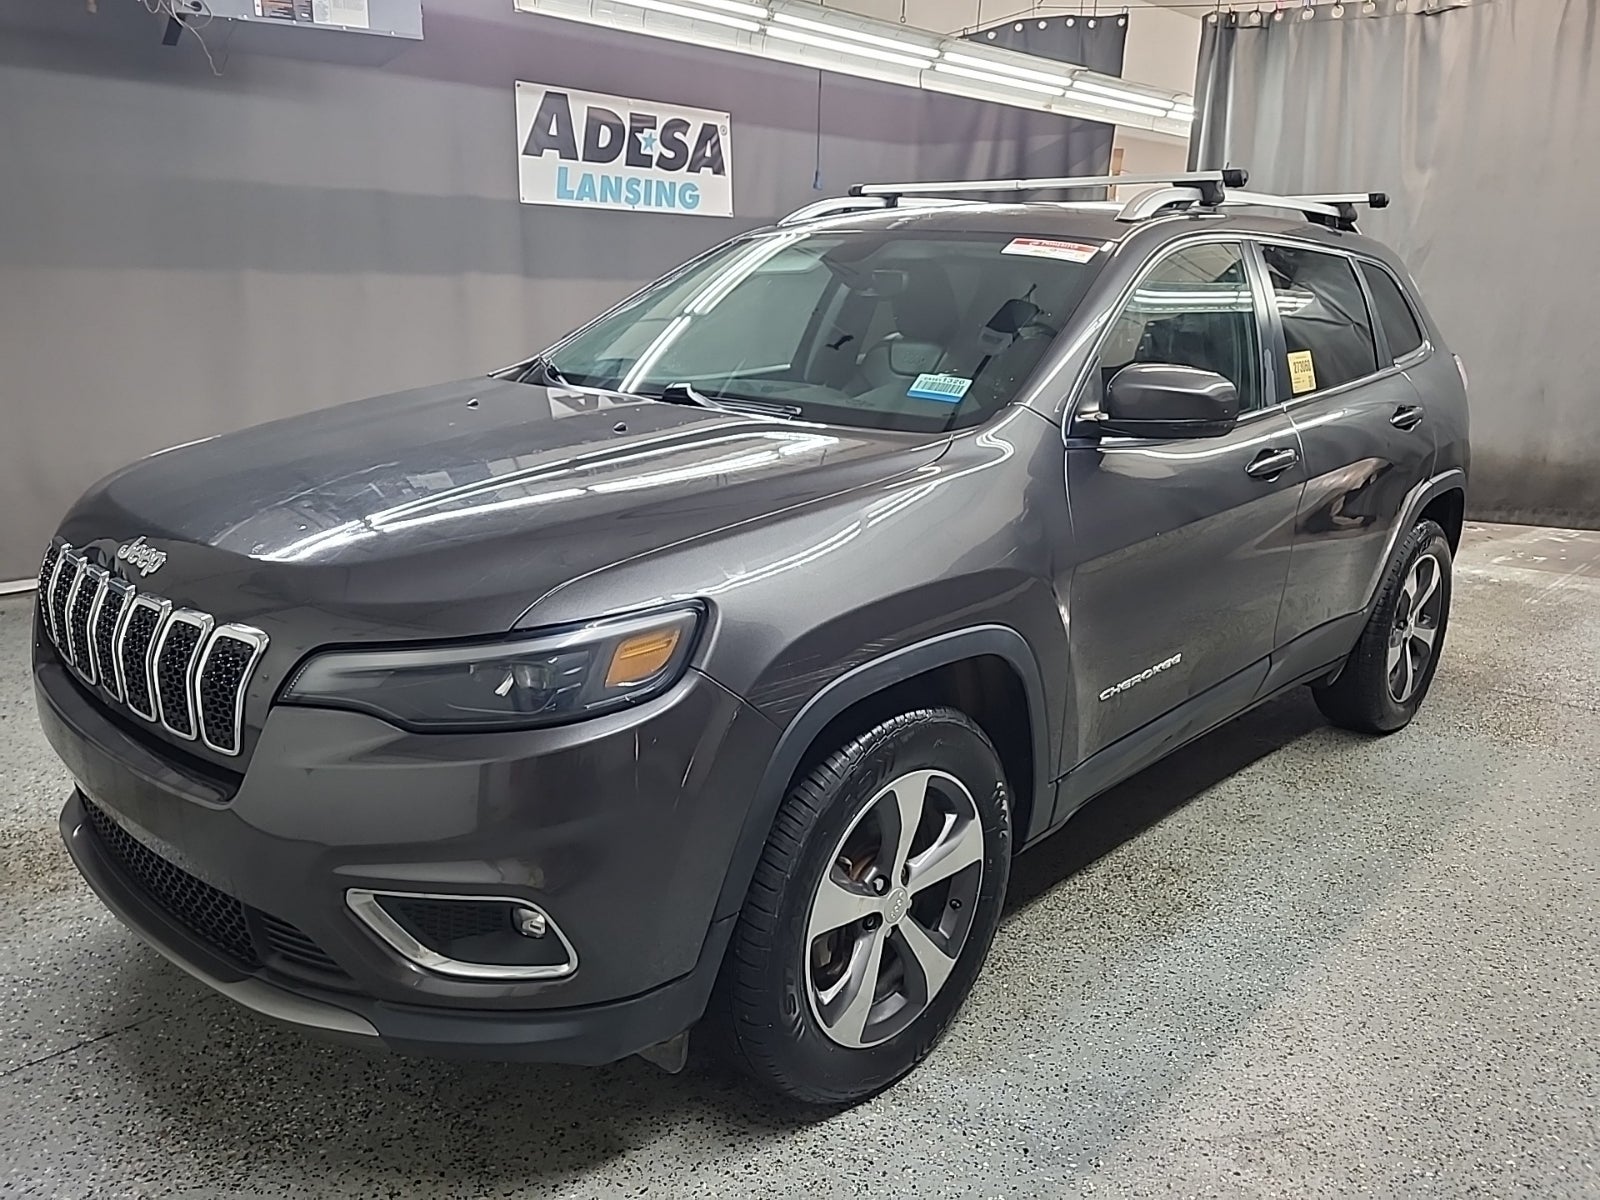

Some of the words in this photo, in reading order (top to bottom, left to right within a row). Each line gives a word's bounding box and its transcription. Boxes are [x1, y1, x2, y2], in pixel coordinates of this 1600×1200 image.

[522, 91, 726, 177] ADESA
[556, 166, 700, 210] LANSING
[117, 535, 167, 577] Jeep
[1099, 652, 1182, 701] CHEROKEE
